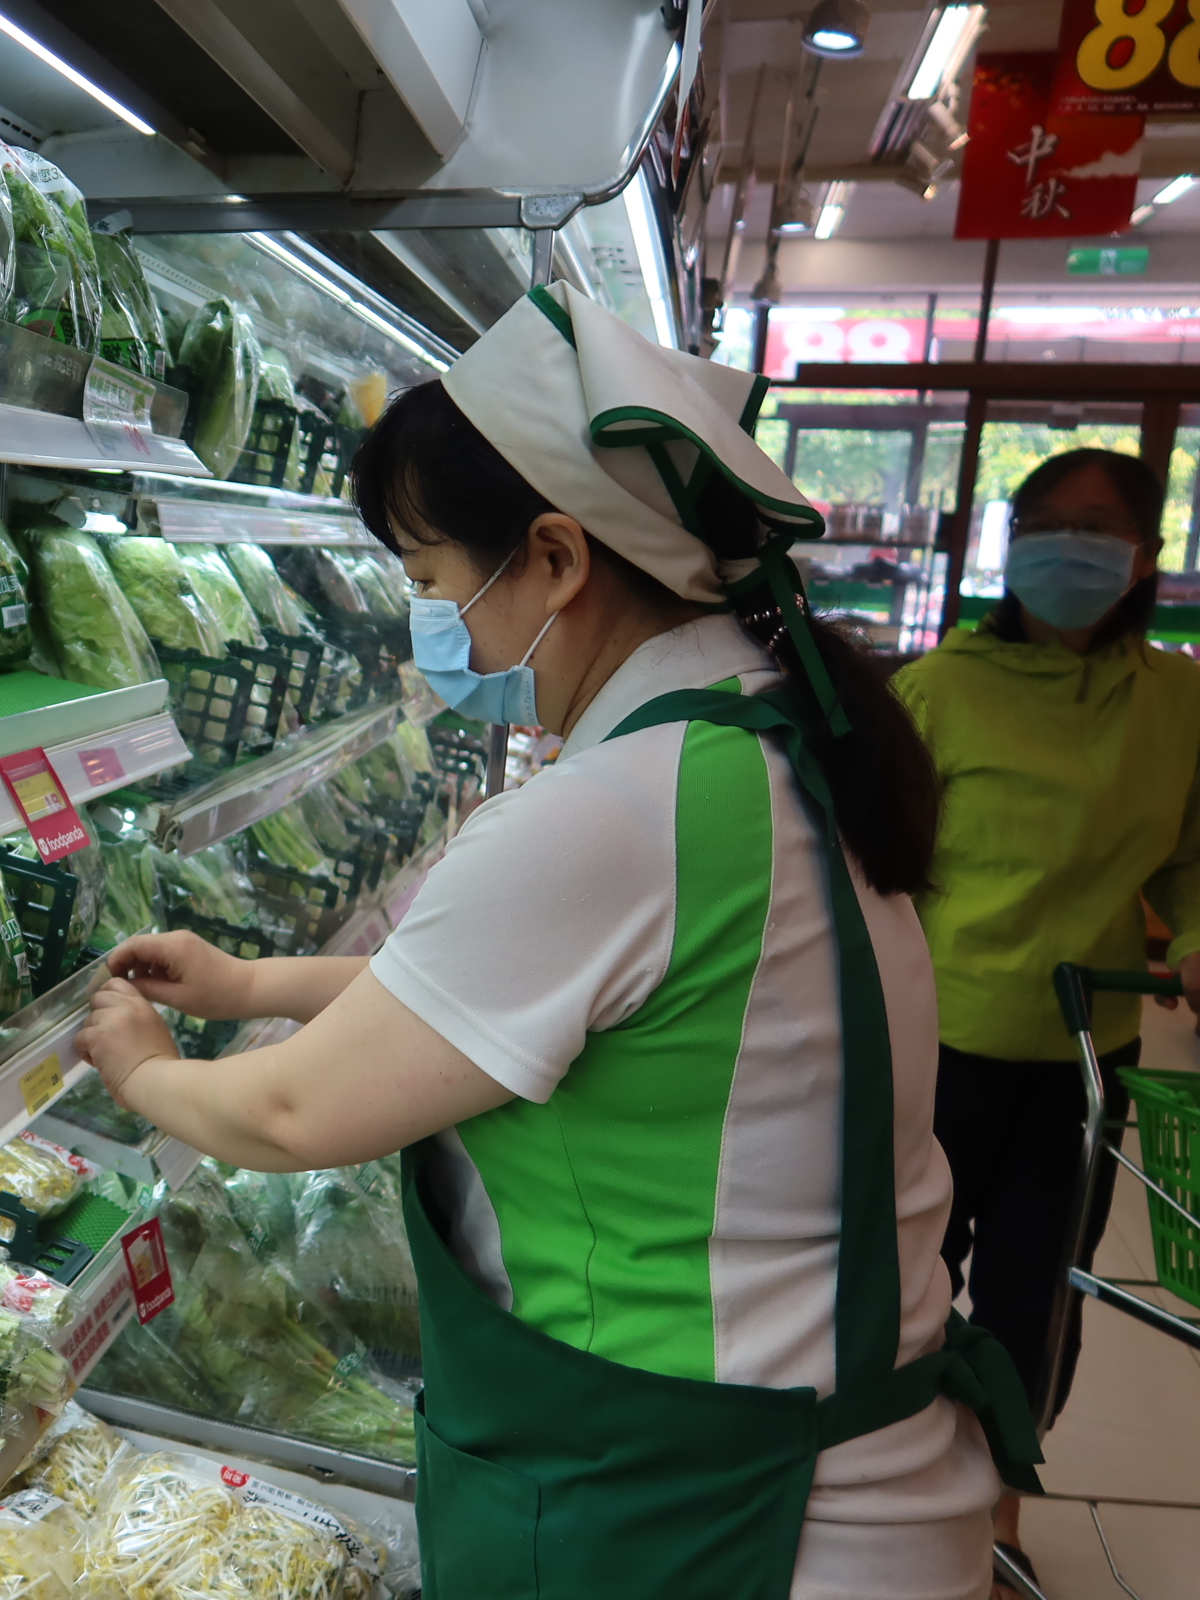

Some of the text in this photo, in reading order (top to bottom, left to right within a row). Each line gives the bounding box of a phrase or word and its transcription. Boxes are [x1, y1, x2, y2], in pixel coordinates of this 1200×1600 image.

[1007, 124, 1071, 220] 中秋
[46, 825, 85, 851] foodpanda
[146, 1287, 173, 1313] foodpanda
